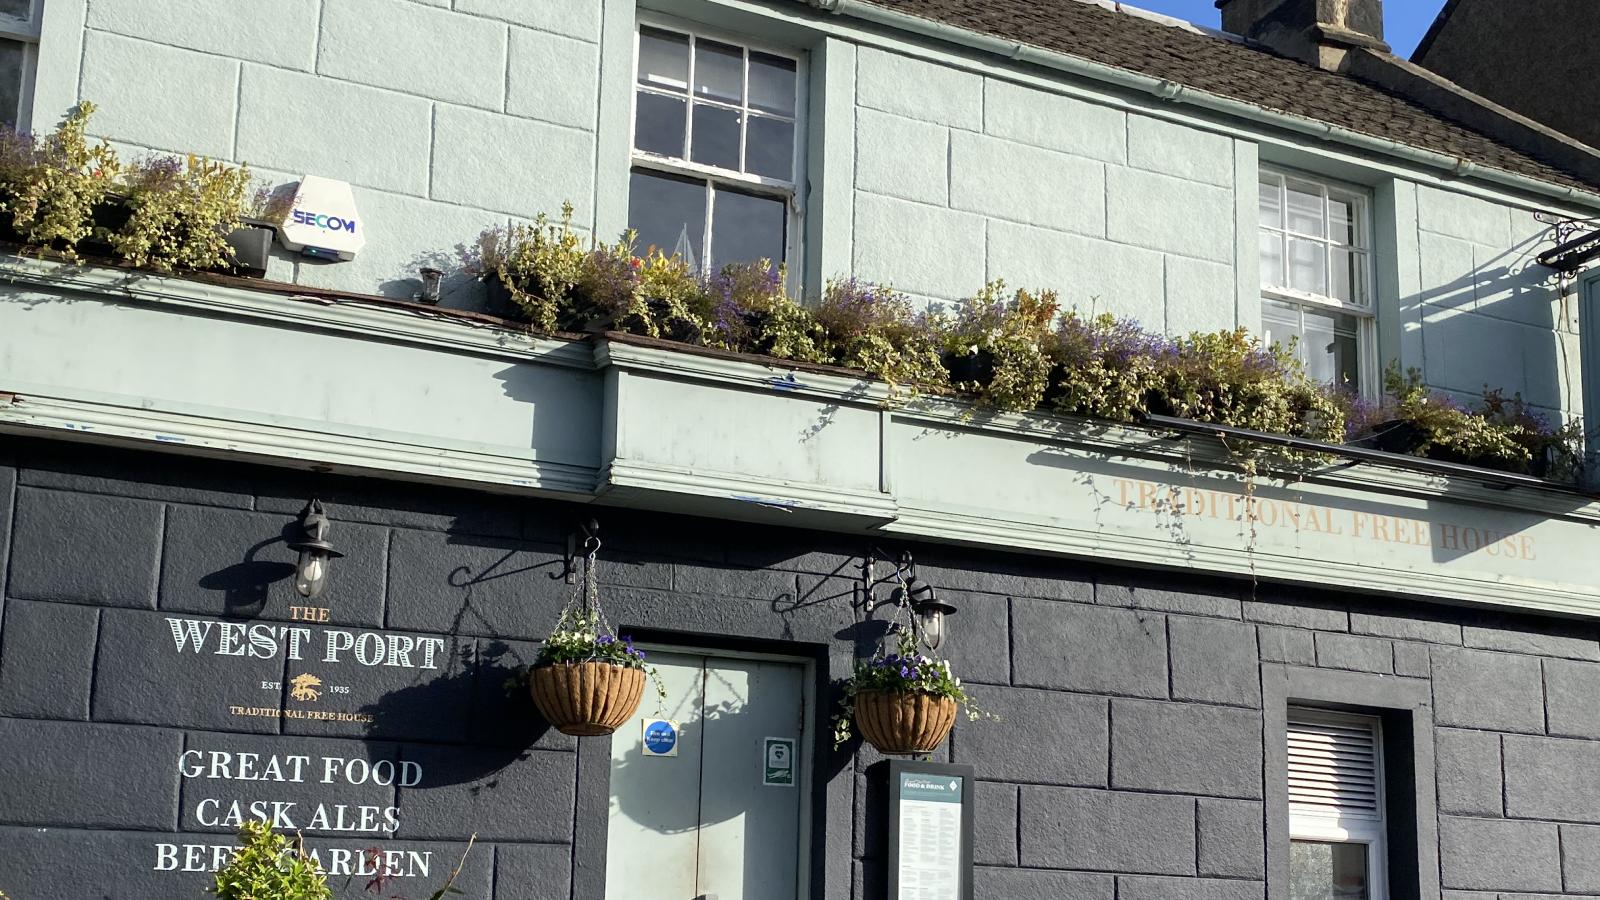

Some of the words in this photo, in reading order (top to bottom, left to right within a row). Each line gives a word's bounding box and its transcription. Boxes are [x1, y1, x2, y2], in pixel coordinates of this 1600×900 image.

[293, 208, 356, 234] SECOM
[1113, 479, 1343, 535] TRADITIONAL
[1352, 511, 1431, 547] FREE
[1440, 523, 1537, 561] HOUSE
[289, 606, 331, 622] THE
[165, 617, 311, 661] WEST
[321, 629, 445, 670] PORT
[329, 685, 350, 694] 1935
[307, 711, 336, 721] FREE
[338, 712, 375, 723] HOUSE
[178, 750, 310, 783] GREAT
[320, 757, 423, 788] FOOD
[196, 798, 297, 830] CASK
[306, 803, 401, 833] ALES
[153, 843, 248, 873] BEE
